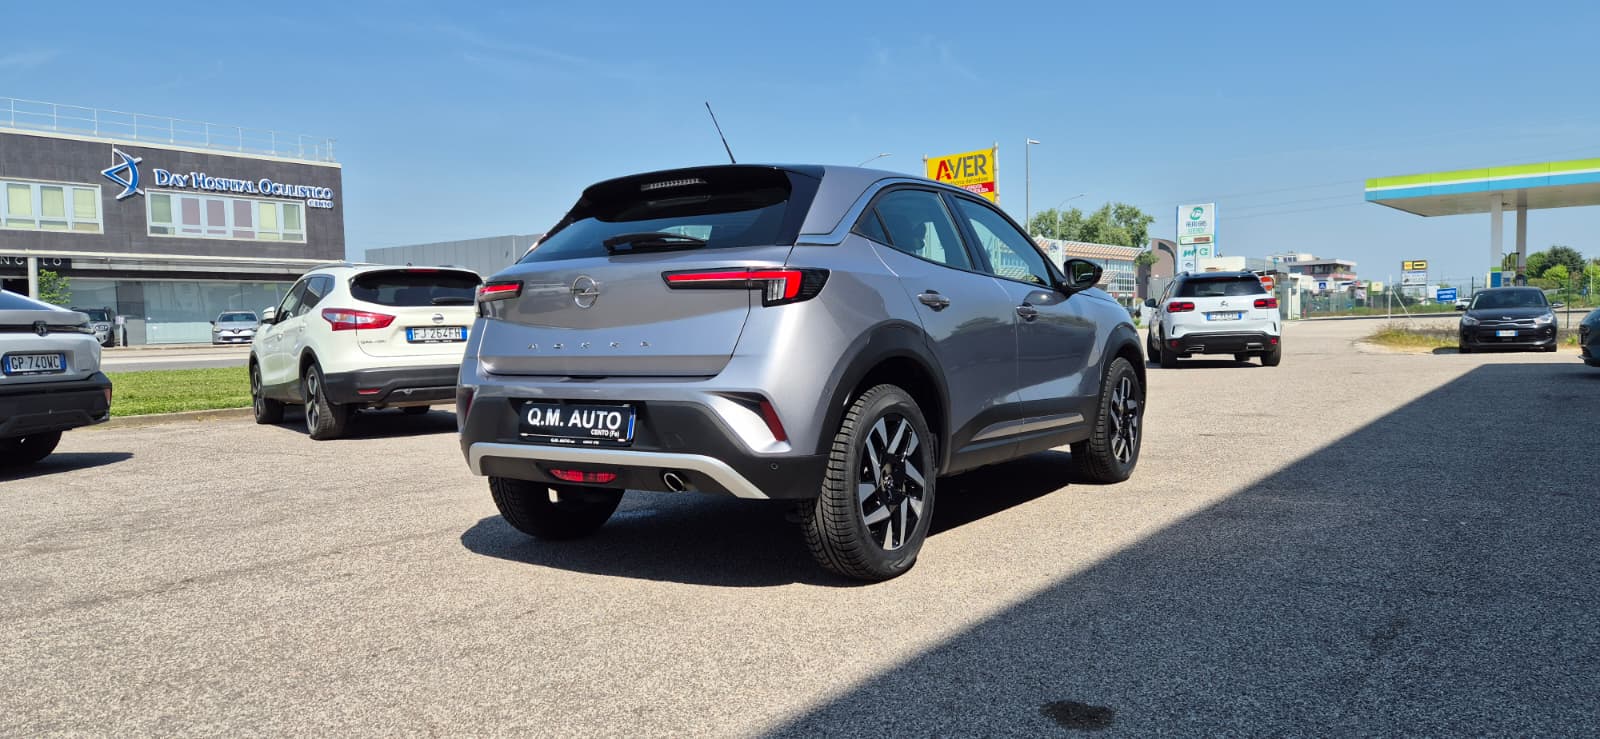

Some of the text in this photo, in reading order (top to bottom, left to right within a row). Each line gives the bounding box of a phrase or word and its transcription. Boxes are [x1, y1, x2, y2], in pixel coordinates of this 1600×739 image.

[936, 154, 987, 180] AVER
[153, 168, 334, 200] DAY HOSPITAL OCULISTICO
[430, 327, 461, 339] 264FH
[11, 355, 60, 370] GP 740WC
[527, 407, 622, 430] Q.M. AUTO
[590, 428, 609, 437] CENTO
